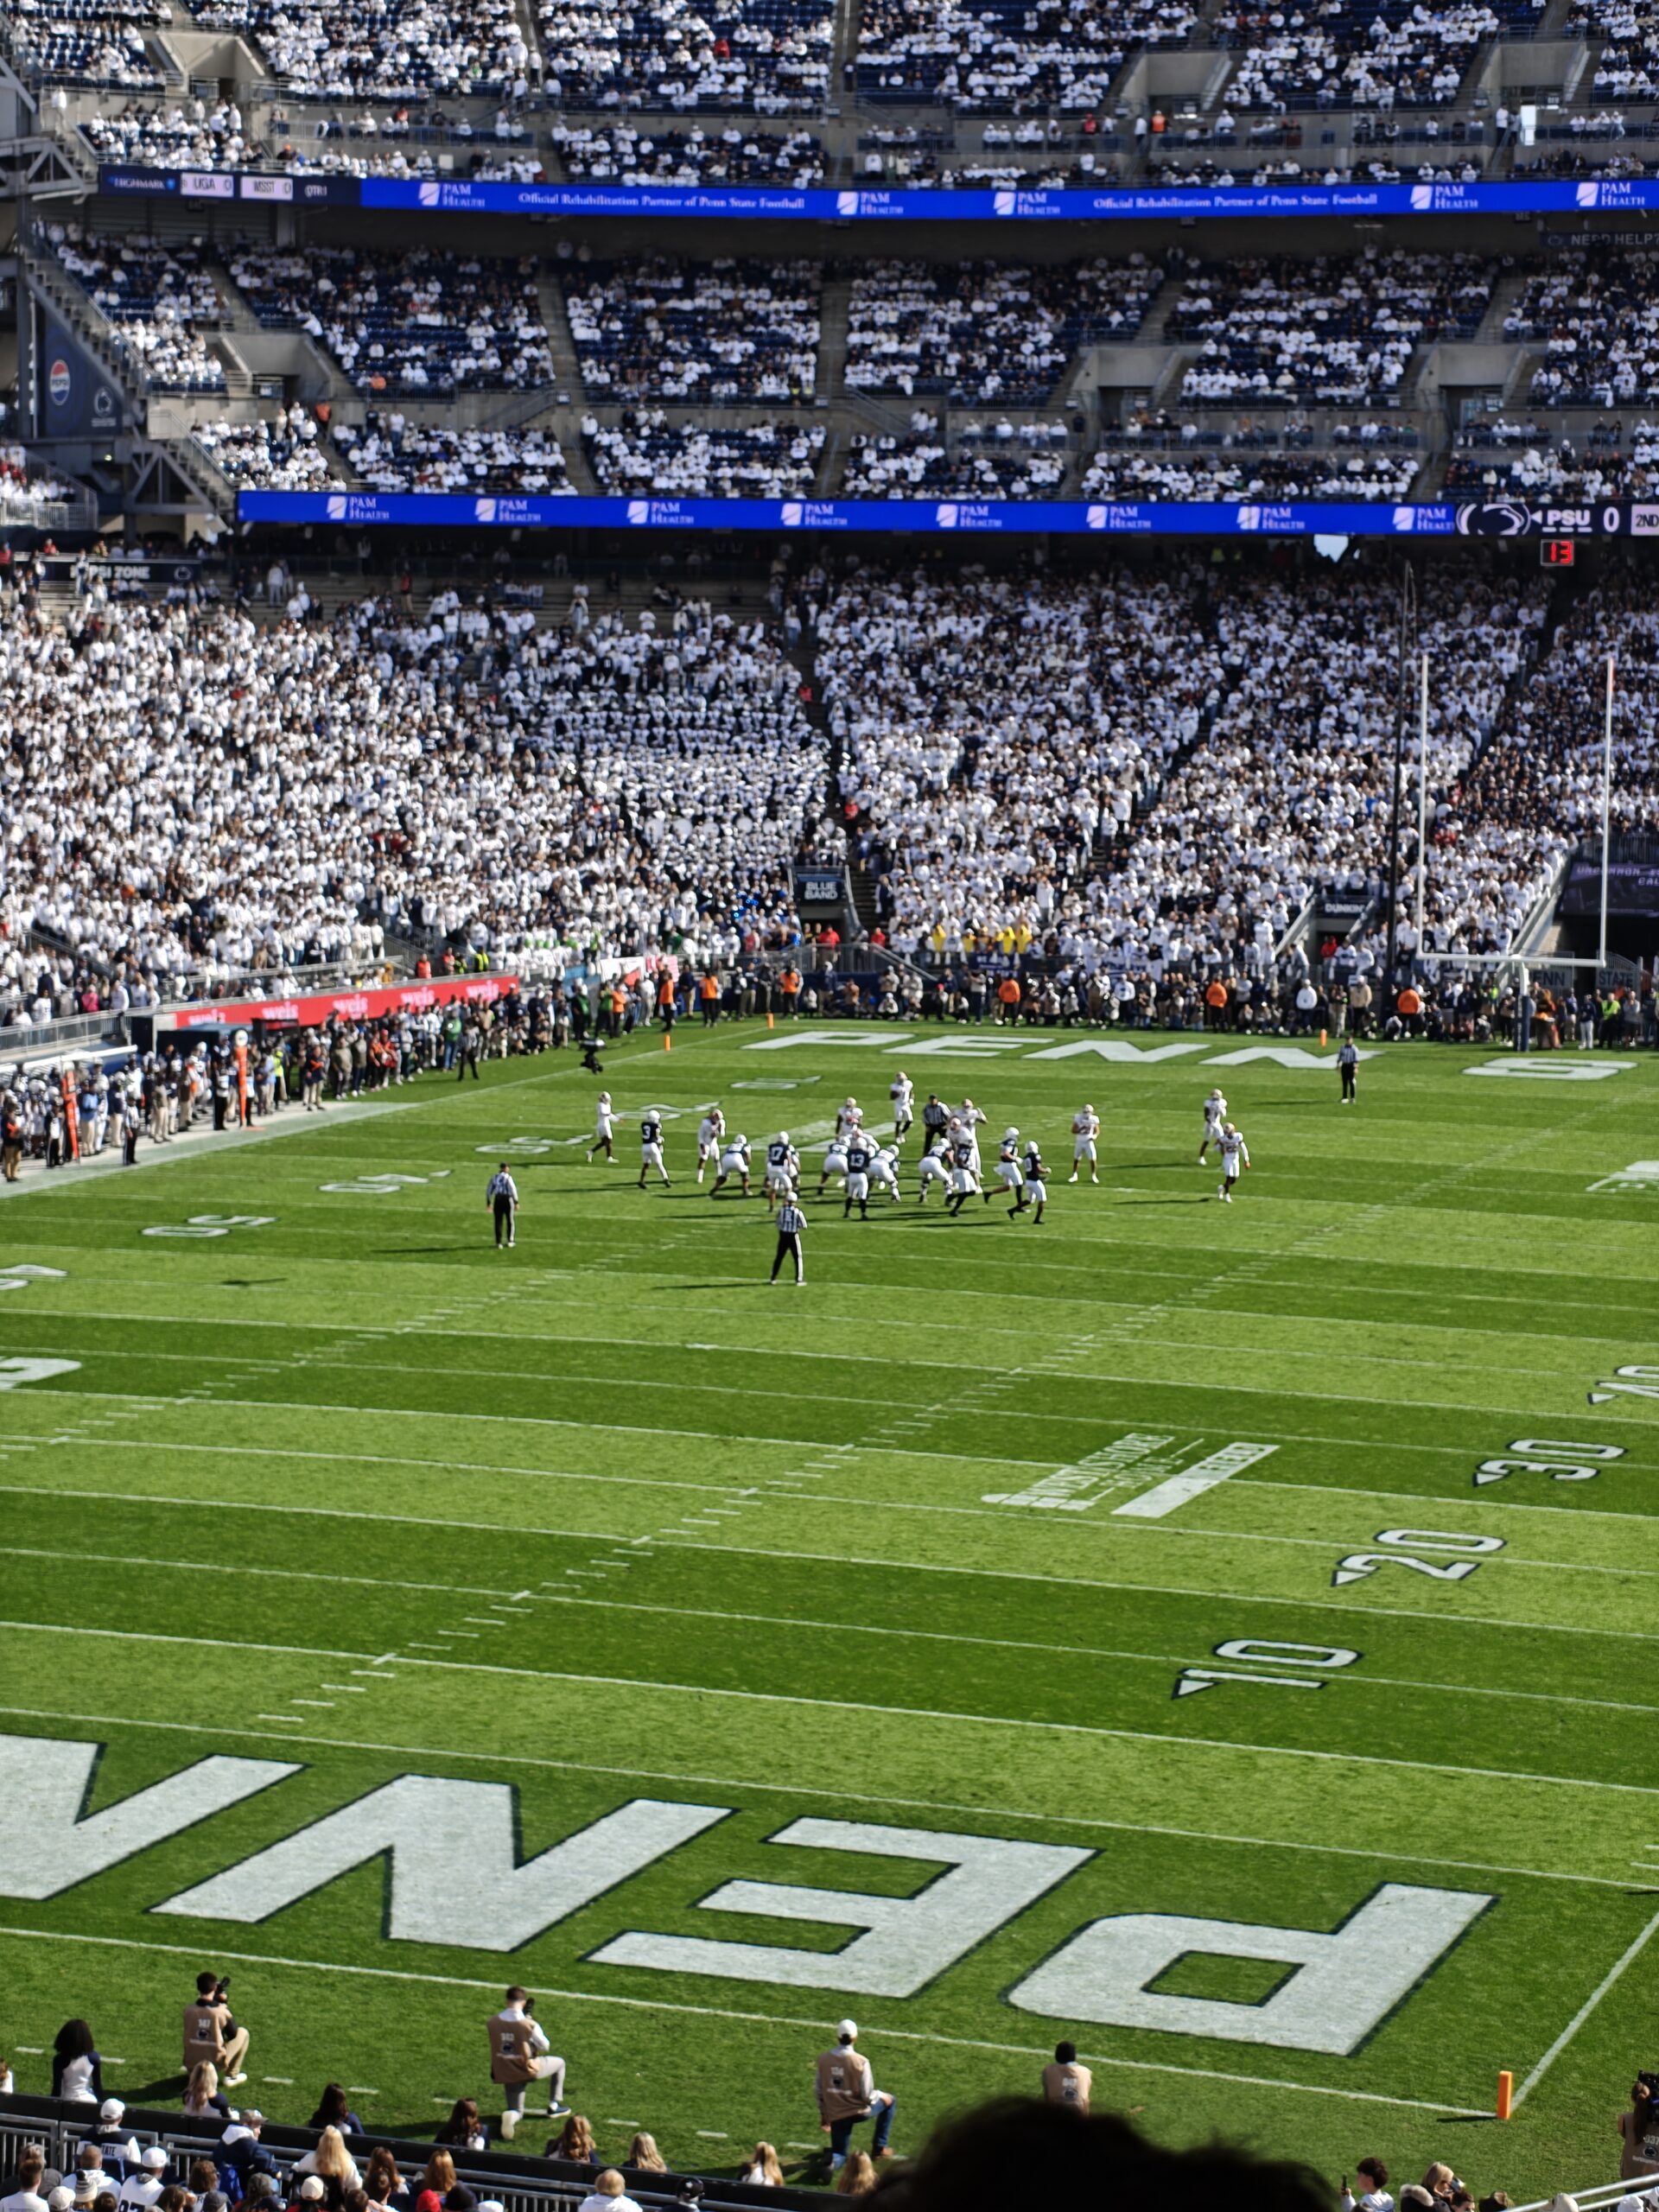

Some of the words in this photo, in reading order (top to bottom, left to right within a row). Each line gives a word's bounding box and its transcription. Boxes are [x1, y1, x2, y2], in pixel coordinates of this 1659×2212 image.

[194, 177, 216, 190] UGA
[442, 184, 471, 195] PAM
[1602, 182, 1630, 194] PAM
[1435, 186, 1465, 196] PAM
[518, 193, 559, 204] Official
[562, 194, 639, 206] Rehabilitation
[641, 195, 683, 207] Partner
[684, 196, 697, 207] of
[699, 197, 727, 207] Penn
[729, 197, 756, 208] State
[760, 198, 805, 209] Football
[861, 192, 890, 203] PAM
[1018, 193, 1047, 203] PAM
[1093, 197, 1134, 208] Official
[1135, 196, 1211, 208] Rehabilitation
[1214, 195, 1255, 207] Partner
[1256, 194, 1269, 206] of
[1270, 195, 1299, 206] Penn
[1300, 194, 1329, 206] State
[1332, 194, 1378, 205] Football
[349, 497, 377, 507] PAM
[499, 499, 527, 511] PAM
[652, 502, 680, 512] PAM
[804, 504, 834, 514] PAM
[960, 505, 988, 516] PAM
[1109, 505, 1138, 517] PAM
[1262, 506, 1292, 518] PAM
[1417, 507, 1446, 518] PAM
[1547, 509, 1591, 526] PSU
[1603, 506, 1620, 532] 0
[1636, 513, 1659, 528] 2ND
[1550, 541, 1573, 564] 13
[114, 566, 150, 580] ZONE
[805, 881, 837, 890] BLUE
[804, 889, 838, 900] BAND
[1532, 971, 1566, 984] ENN
[1599, 971, 1634, 987] STATE
[741, 1031, 1385, 1070] PENN
[642, 1124, 652, 1140] 3
[850, 1154, 866, 1167] 13
[1477, 1438, 1627, 1482] 30
[1336, 1528, 1507, 1581] 20
[1179, 1638, 1363, 1689] 10
